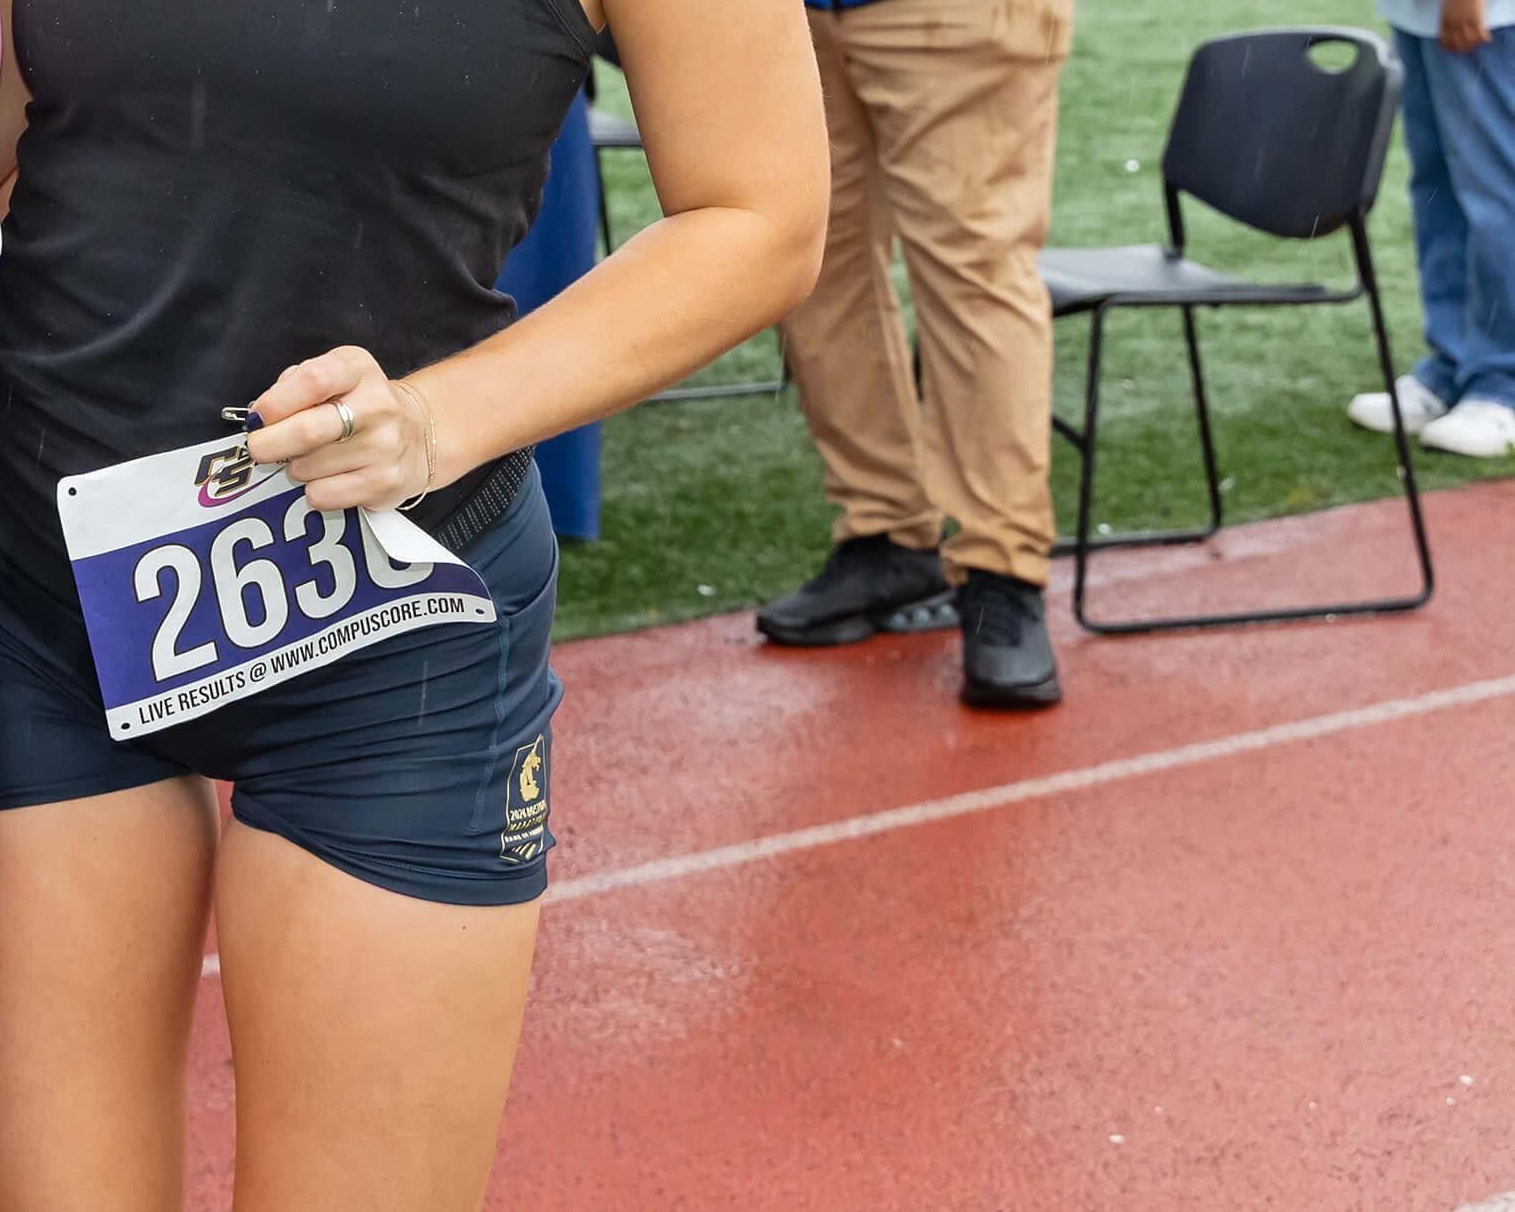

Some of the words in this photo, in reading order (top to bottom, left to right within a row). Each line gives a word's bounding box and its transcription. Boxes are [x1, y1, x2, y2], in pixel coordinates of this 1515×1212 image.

[138, 697, 175, 724] LIVE
[177, 671, 246, 712] RESULTS
[249, 661, 267, 683] @
[270, 597, 465, 675] WWW.COMPUSCORE.COM
